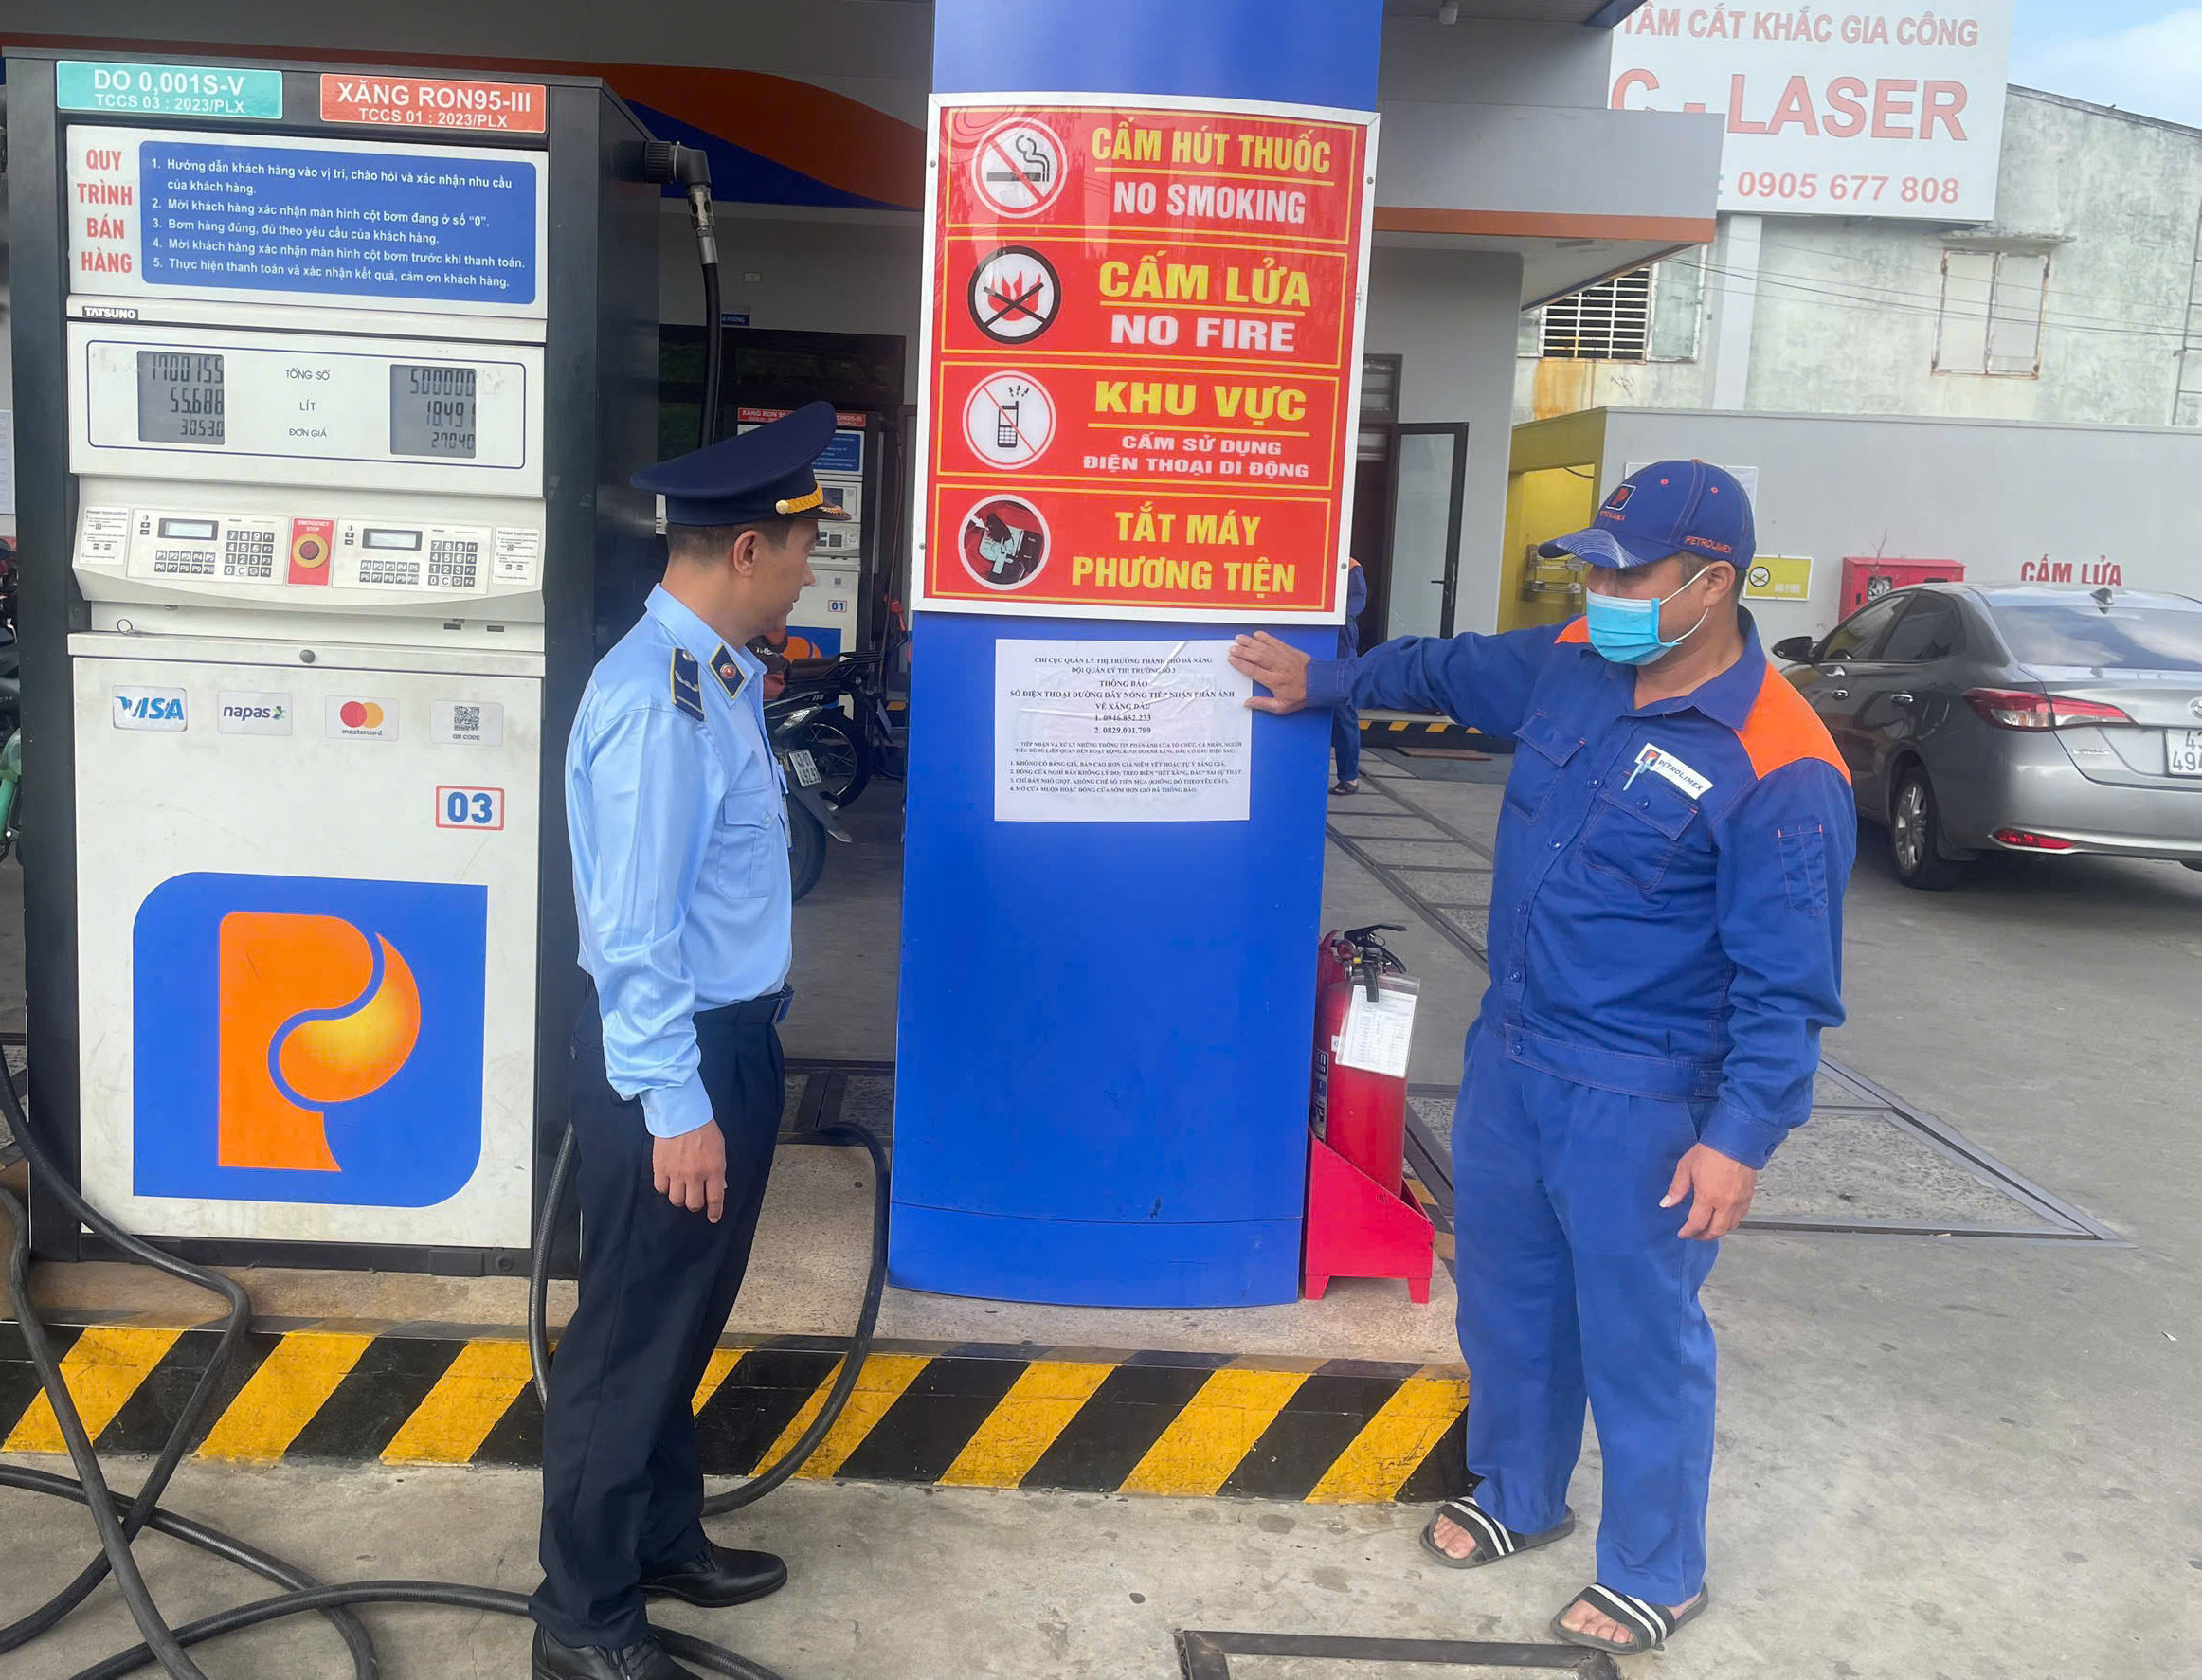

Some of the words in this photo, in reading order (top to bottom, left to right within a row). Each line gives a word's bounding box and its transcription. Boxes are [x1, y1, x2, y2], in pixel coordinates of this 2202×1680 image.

[1688, 2, 1747, 39] CẮT
[1753, 6, 1833, 43] KHẮC
[1840, 15, 1889, 44] GIA
[1896, 10, 1978, 47] CÔNG
[95, 68, 131, 91] DO
[138, 71, 244, 96] 0,001S-V
[95, 93, 138, 108] TCCS
[142, 96, 160, 109] 03
[174, 97, 244, 114] 2023/PLX
[337, 80, 409, 106] XĂNG
[419, 86, 531, 113] RON95-III
[1726, 74, 1969, 142] LASER
[358, 108, 402, 123] TCCS
[406, 111, 423, 124] 01
[438, 112, 508, 128] 2023/PLX
[1092, 117, 1161, 162] CẤM
[1172, 125, 1229, 165] HÚT
[1238, 129, 1330, 173] THUỐC
[85, 149, 123, 171] QUY
[167, 158, 206, 173] Hướng
[208, 159, 229, 172] dẫn
[232, 162, 265, 174] khách
[268, 164, 296, 178] hàng
[298, 166, 318, 177] vào
[320, 168, 330, 181] vị
[334, 169, 348, 181] trí,
[351, 169, 378, 181] chào
[381, 171, 398, 182] hỏi
[401, 172, 413, 183] và
[417, 172, 436, 184] xác
[439, 174, 465, 188] nhận
[469, 176, 489, 188] nhu
[493, 175, 512, 189] cầu
[76, 178, 133, 207] TRÌNH
[167, 179, 188, 190] của
[190, 180, 223, 191] khách
[226, 182, 256, 196] hàng.
[1737, 171, 1818, 200] 0905
[1829, 174, 1889, 201] 677
[1899, 176, 1959, 204] 808
[168, 198, 189, 210] Mời
[191, 200, 225, 212] khách
[227, 202, 255, 216] hàng
[258, 204, 277, 215] xác
[280, 205, 307, 218] nhận
[310, 207, 334, 218] màn
[336, 208, 360, 220] hình
[363, 209, 381, 223] cột
[383, 210, 408, 222] bơm
[411, 212, 438, 226] đang
[453, 212, 466, 226] số
[1113, 181, 1156, 214] NO
[1166, 183, 1306, 225] SMOKING
[86, 213, 125, 240] BÁN
[169, 218, 194, 229] Bơm
[198, 220, 225, 234] hàng
[227, 222, 259, 236] đúng,
[262, 224, 276, 235] đủ
[279, 225, 303, 236] theo
[305, 226, 325, 239] yêu
[328, 226, 348, 239] cầu
[351, 228, 370, 240] của
[373, 229, 406, 242] khách
[409, 231, 439, 246] hàng.
[81, 246, 133, 274] HÀNG
[169, 258, 197, 271] Thực
[201, 260, 224, 273] hiện
[226, 262, 258, 273] thanh
[261, 263, 284, 274] toán
[287, 264, 300, 275] và
[303, 265, 322, 277] xác
[325, 267, 352, 280] nhận
[355, 266, 371, 280] kết
[374, 270, 397, 282] quả,
[400, 271, 423, 282] cảm
[426, 275, 442, 283] ơn
[444, 273, 477, 284] khách
[479, 275, 509, 289] hàng.
[1098, 249, 1209, 301] CẤM
[1226, 256, 1311, 307] LỬA
[83, 307, 136, 319] TATSUNO
[1110, 314, 1179, 346] NO
[1195, 316, 1295, 352] FIRE
[285, 368, 313, 380] TỔNG
[316, 369, 331, 381] SỐ
[409, 368, 475, 397] 500000
[299, 398, 316, 411] LÍT
[1094, 381, 1197, 417] KHU
[1213, 385, 1308, 426] VỰC
[180, 418, 224, 437] 30530
[289, 427, 309, 437] ĐƠN
[311, 426, 328, 438] GIÁ
[1121, 432, 1175, 452] CẤM
[1182, 434, 1215, 452] SỬ
[1219, 438, 1282, 457] DỤNG
[1083, 453, 1138, 473] ĐIỆN
[1146, 458, 1212, 477] THOẠI
[1219, 459, 1242, 475] DI
[1249, 461, 1309, 478] ĐỘNG
[1114, 500, 1177, 544] TẮT
[1186, 510, 1261, 546] MÁY
[1071, 555, 1212, 591] PHƯƠNG
[1222, 554, 1295, 598] TIỆN
[2020, 553, 2073, 584] CẤM
[2081, 554, 2122, 587] LỬA
[831, 602, 844, 611] 01
[116, 695, 186, 720] VISA
[222, 703, 271, 722] napas
[341, 728, 383, 736] mastercard
[1103, 726, 1151, 734] 0829.001.799
[2185, 730, 2202, 750] 4
[447, 792, 493, 823] 03
